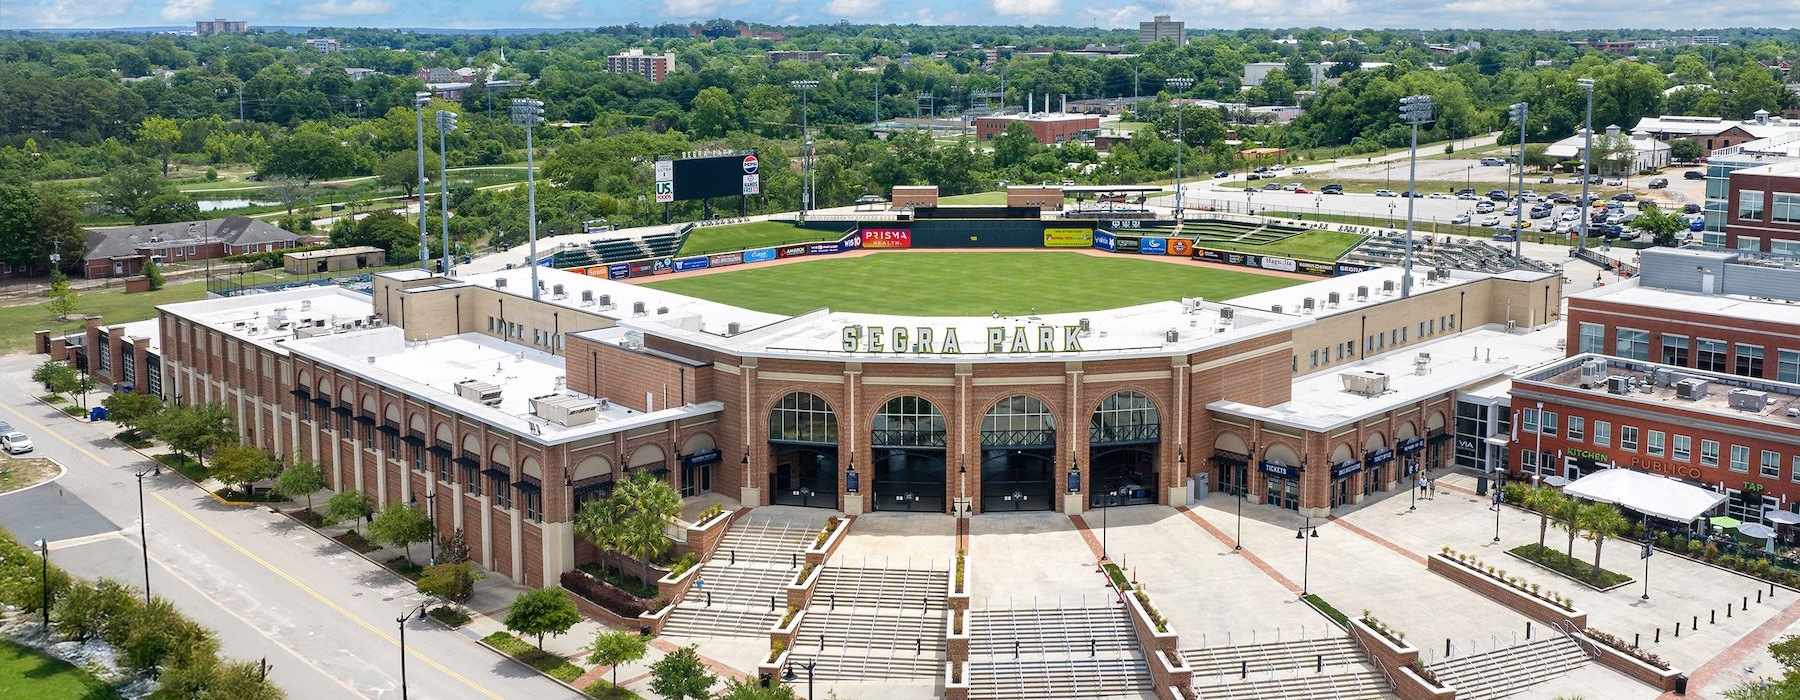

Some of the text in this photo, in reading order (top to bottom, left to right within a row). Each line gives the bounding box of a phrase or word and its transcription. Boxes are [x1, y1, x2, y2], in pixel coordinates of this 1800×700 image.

[866, 231, 907, 240] PRISMA
[842, 325, 1084, 354] SEGRA PARK
[1459, 440, 1474, 448] VIA
[1567, 447, 1608, 462] KITCHEN
[1266, 464, 1287, 475] TICKETS
[1631, 457, 1701, 479] PUBLICO
[1743, 481, 1764, 492] TAP
